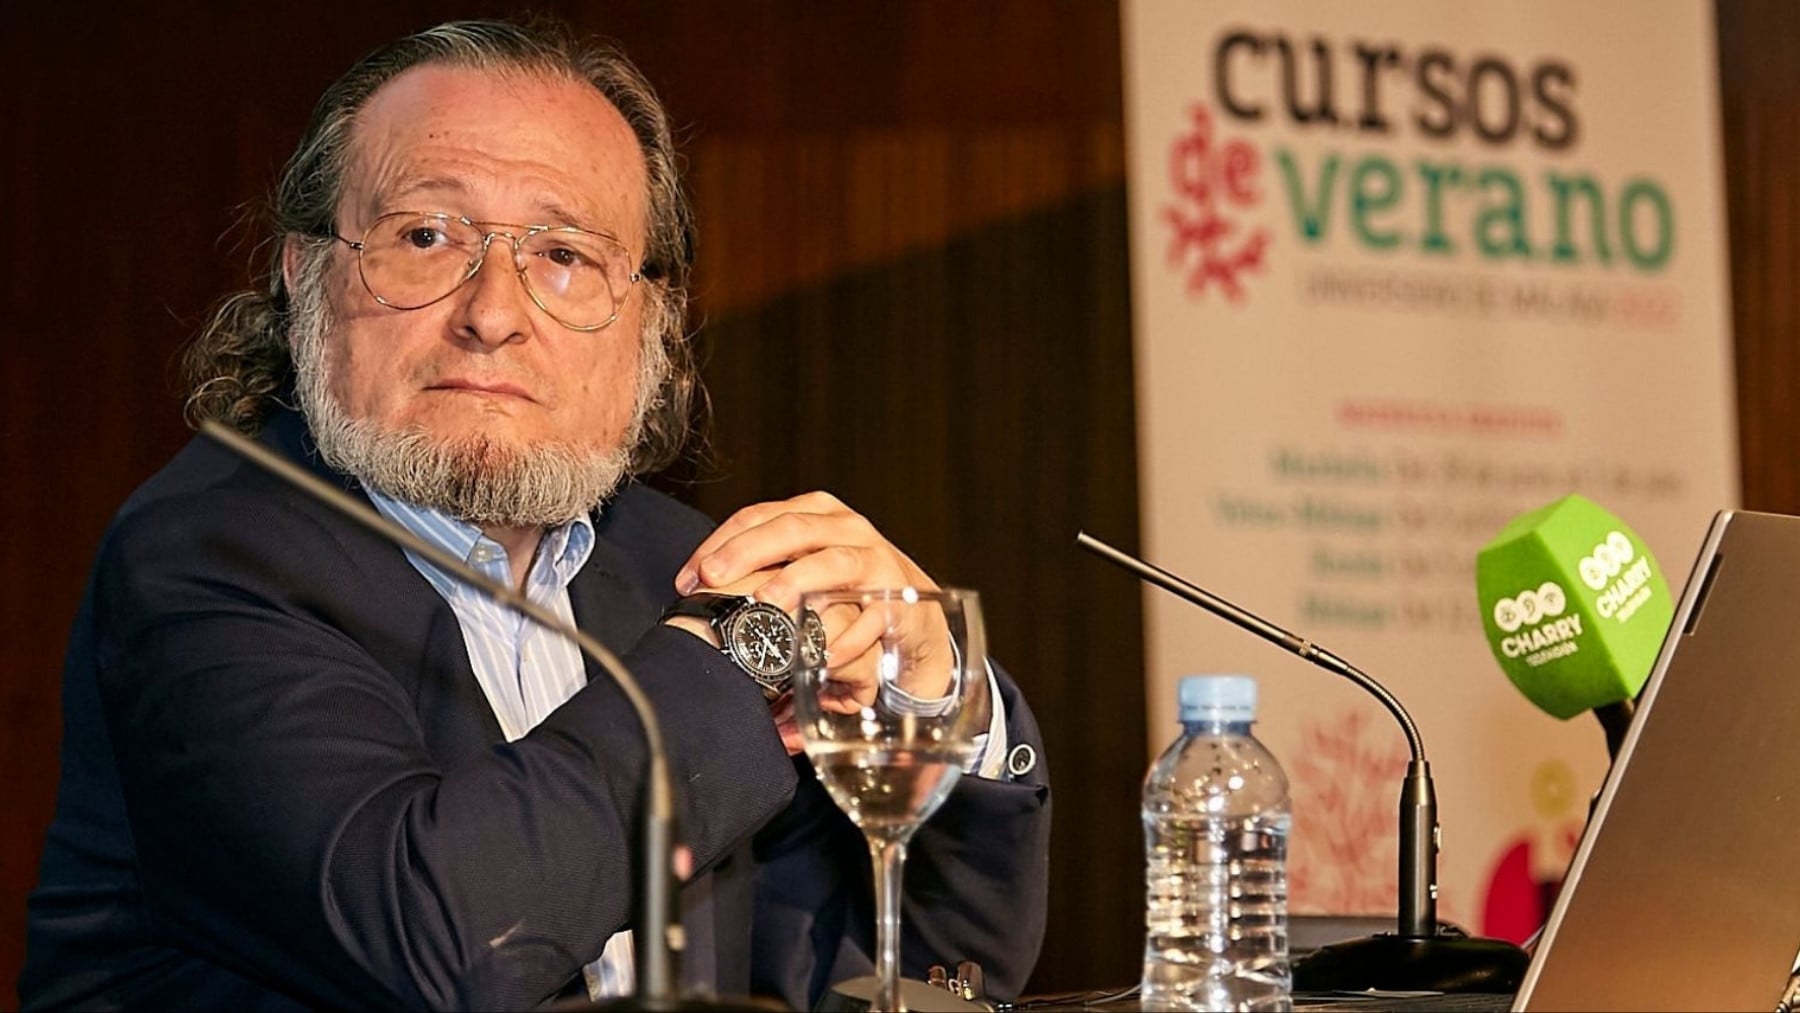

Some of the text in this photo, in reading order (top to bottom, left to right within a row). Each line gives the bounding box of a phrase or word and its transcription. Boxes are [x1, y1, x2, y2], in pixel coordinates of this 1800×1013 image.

[1213, 28, 1579, 153] cursos
[1168, 104, 1675, 270] de verano
[1596, 555, 1652, 618] CHARRY
[1501, 613, 1582, 658] CHARRY
